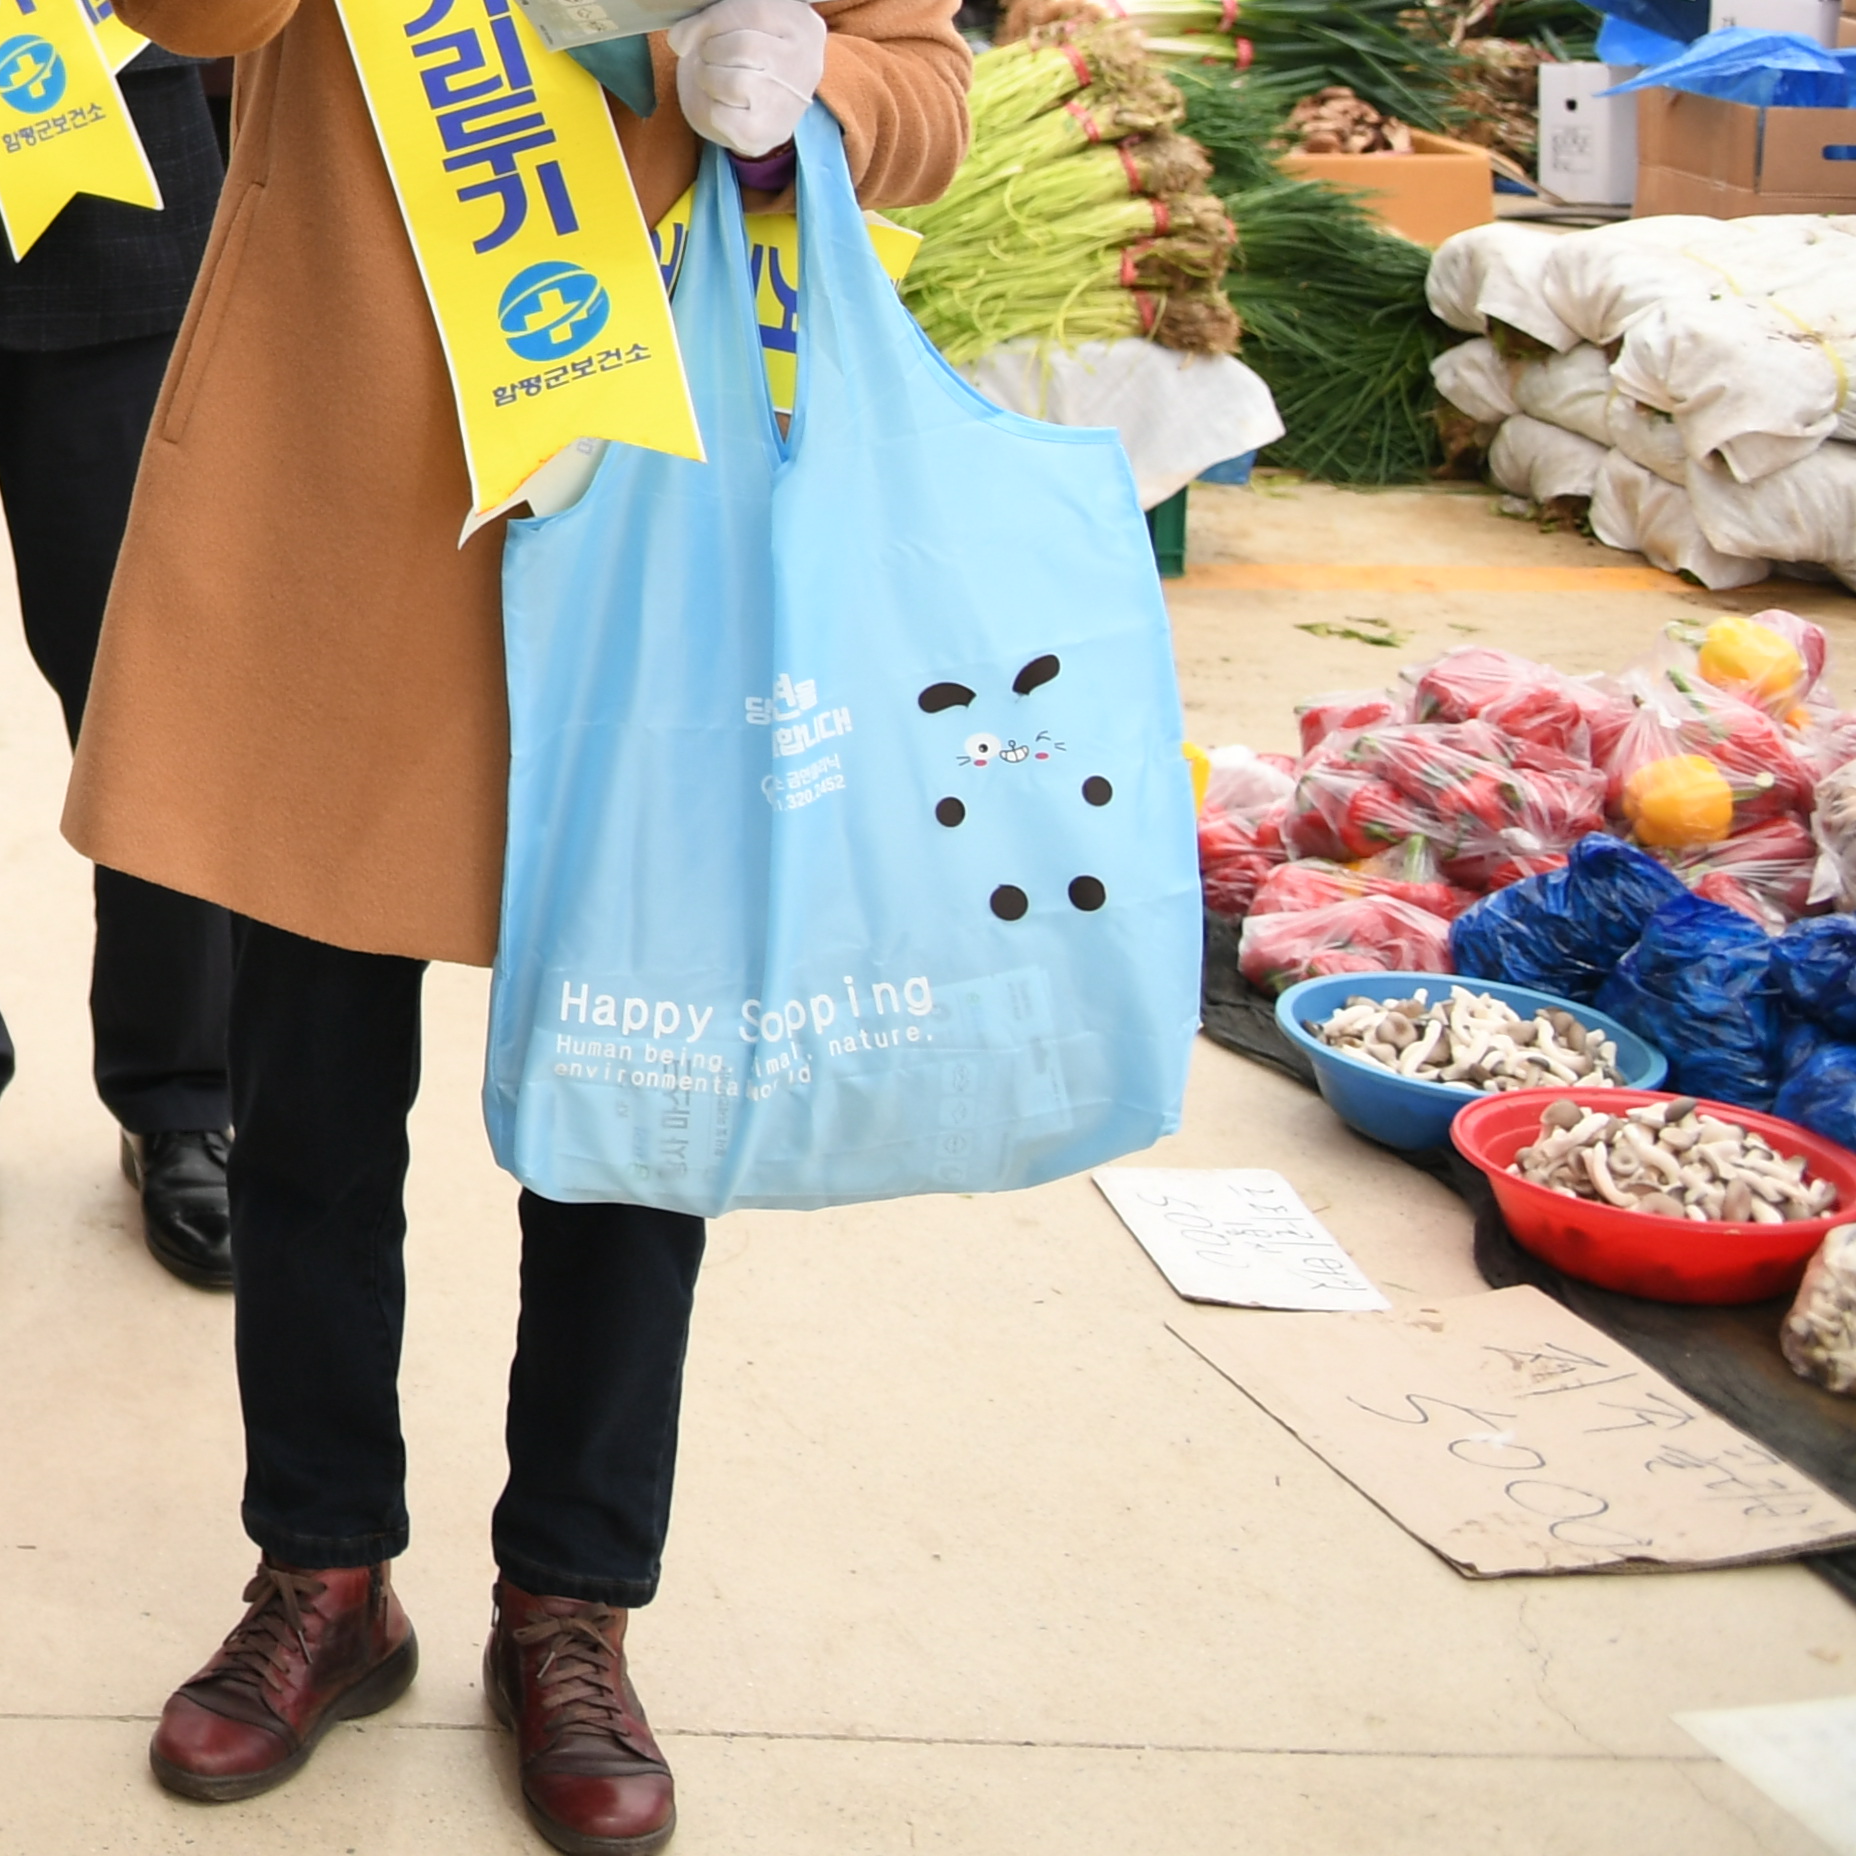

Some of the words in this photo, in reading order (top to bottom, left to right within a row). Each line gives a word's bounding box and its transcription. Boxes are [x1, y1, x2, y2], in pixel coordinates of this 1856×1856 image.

[1, 100, 106, 154] 함평군보건소
[491, 341, 652, 408] 함평군보건소
[771, 707, 853, 759] 합니다!
[559, 980, 714, 1043] Happy
[556, 1033, 633, 1063] Human
[1136, 1191, 1250, 1270] 5000
[1346, 1391, 1654, 1550] 5000
